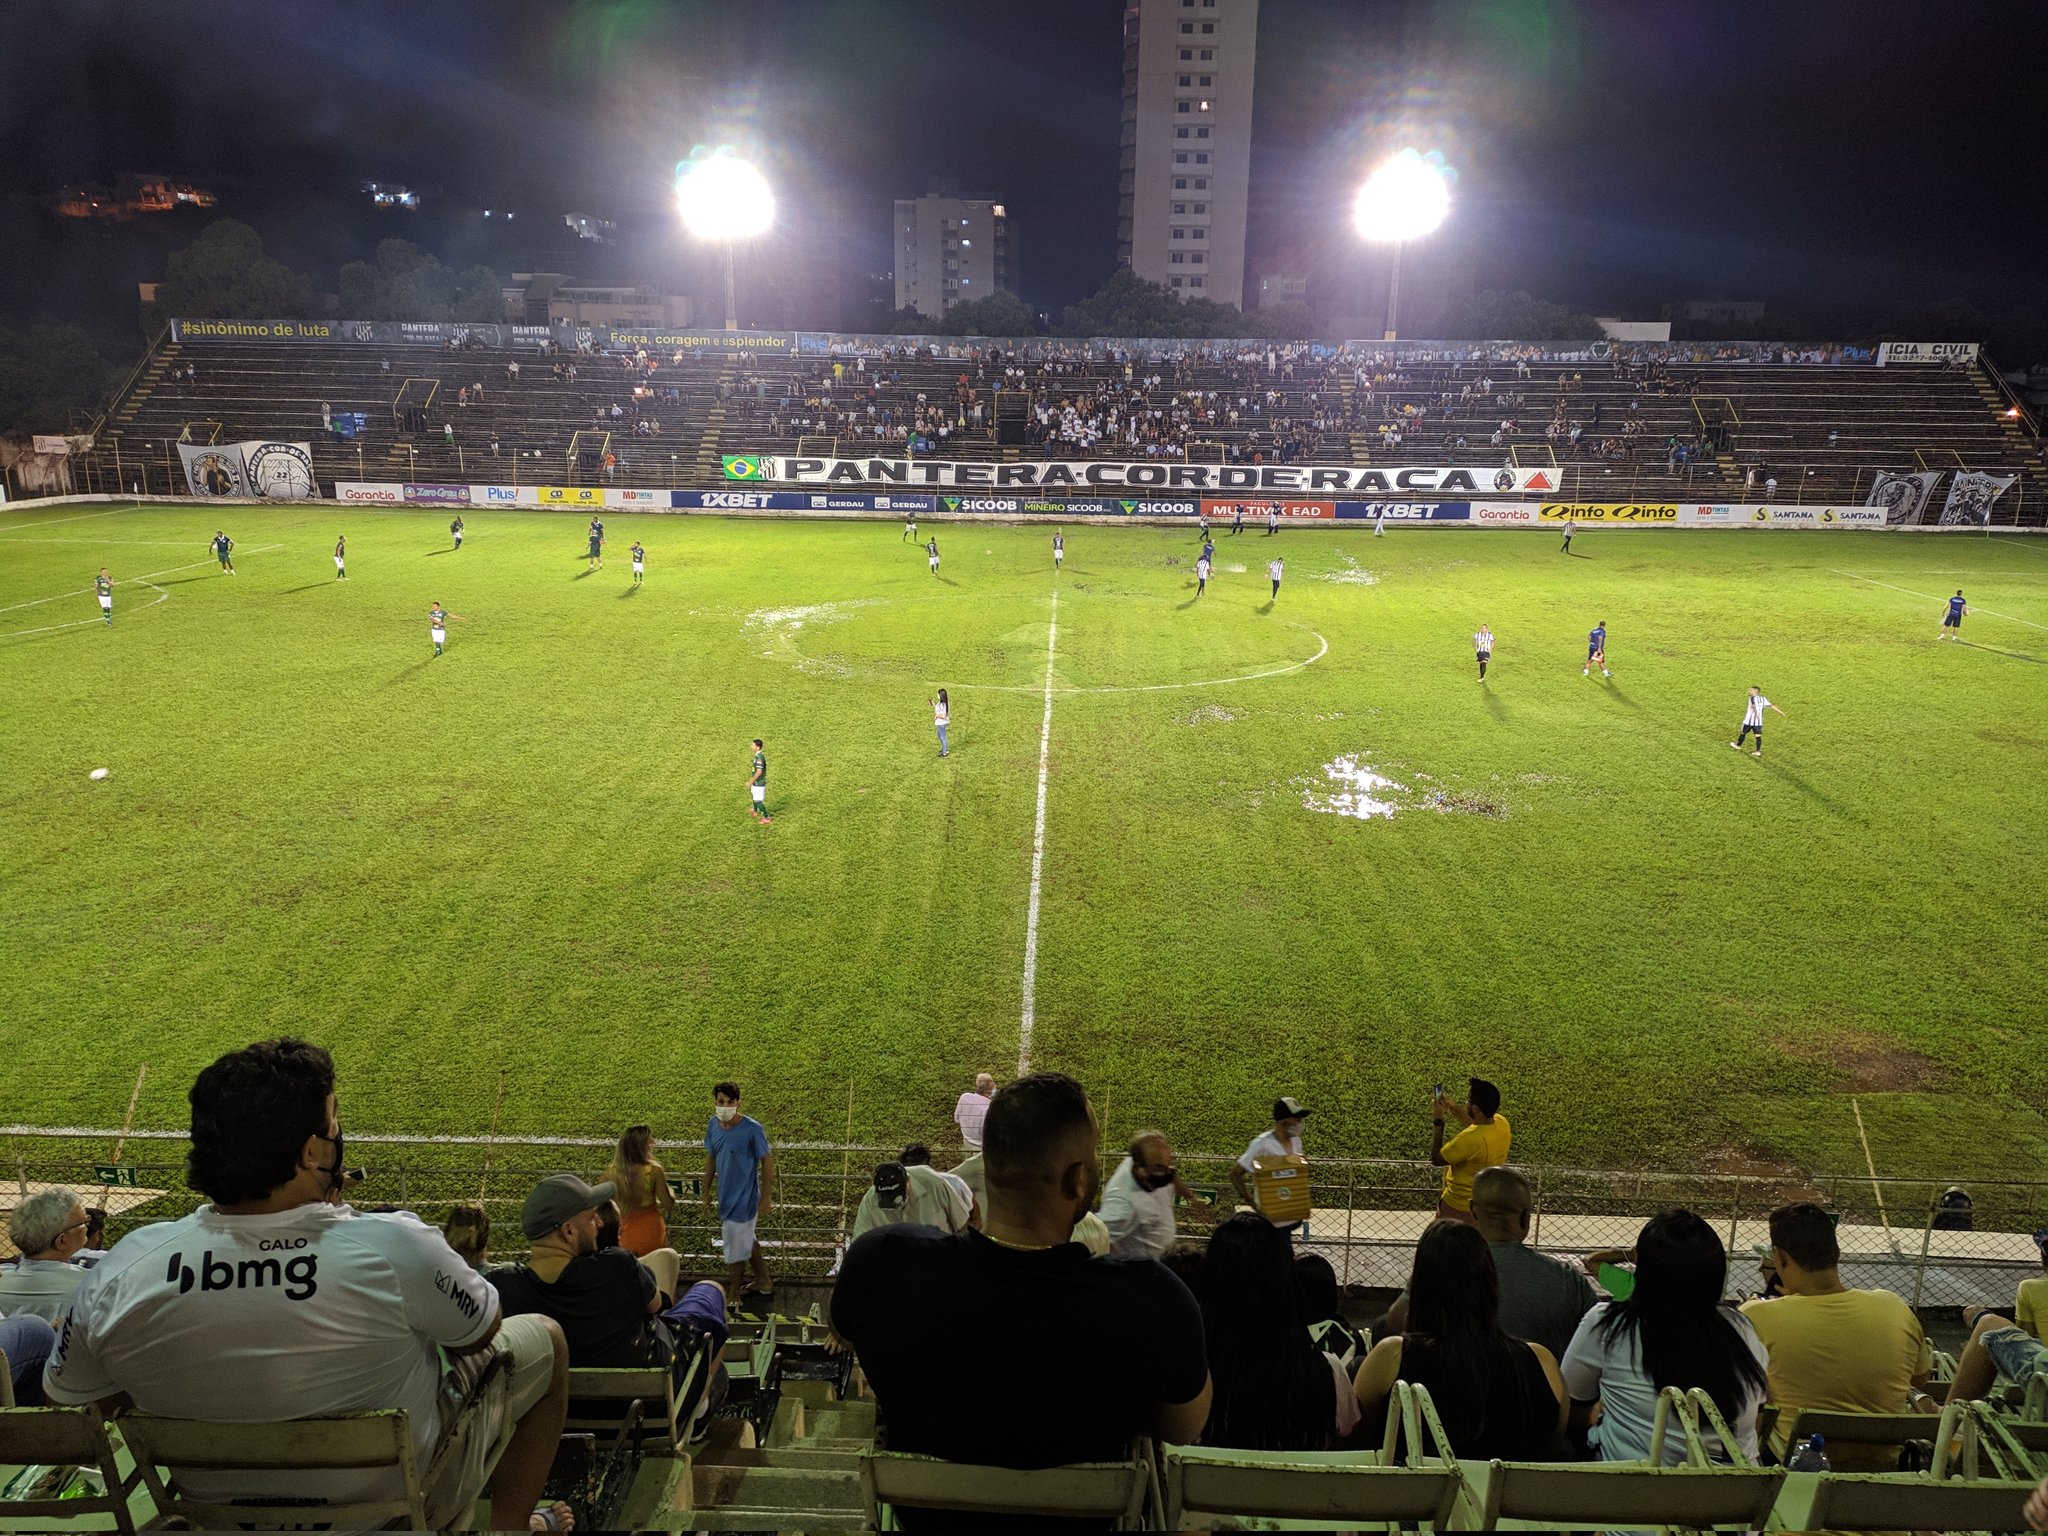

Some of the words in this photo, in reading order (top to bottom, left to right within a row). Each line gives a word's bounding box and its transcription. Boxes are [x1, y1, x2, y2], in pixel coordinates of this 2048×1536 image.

[181, 321, 270, 337] #sinônimo
[273, 322, 293, 337] de
[298, 323, 330, 337] luta
[655, 334, 711, 348] coragem
[713, 338, 720, 346] e
[722, 333, 786, 349] esplendor
[1842, 346, 1877, 361] Plus!
[1886, 343, 1919, 355] ÍCIA
[1931, 344, 1972, 355] CIVIL
[345, 489, 396, 500] Garantia
[488, 487, 519, 501] Plus!
[550, 490, 563, 498] CD
[579, 491, 592, 499] CD
[700, 493, 773, 508] 1XBET
[891, 501, 928, 509] GERDAU
[961, 499, 1018, 511] SICOOB
[1024, 503, 1066, 512] MINEIRO
[1066, 504, 1103, 512] SICOOB
[1137, 502, 1195, 514] SICOOB
[1292, 506, 1322, 516] EAD
[1479, 508, 1530, 520] Garantia
[1773, 511, 1814, 519] SANTANA
[1839, 512, 1881, 520] SANTANA
[259, 1237, 308, 1251] GALO
[201, 1250, 318, 1301] bmg
[450, 1280, 480, 1319] MRV
